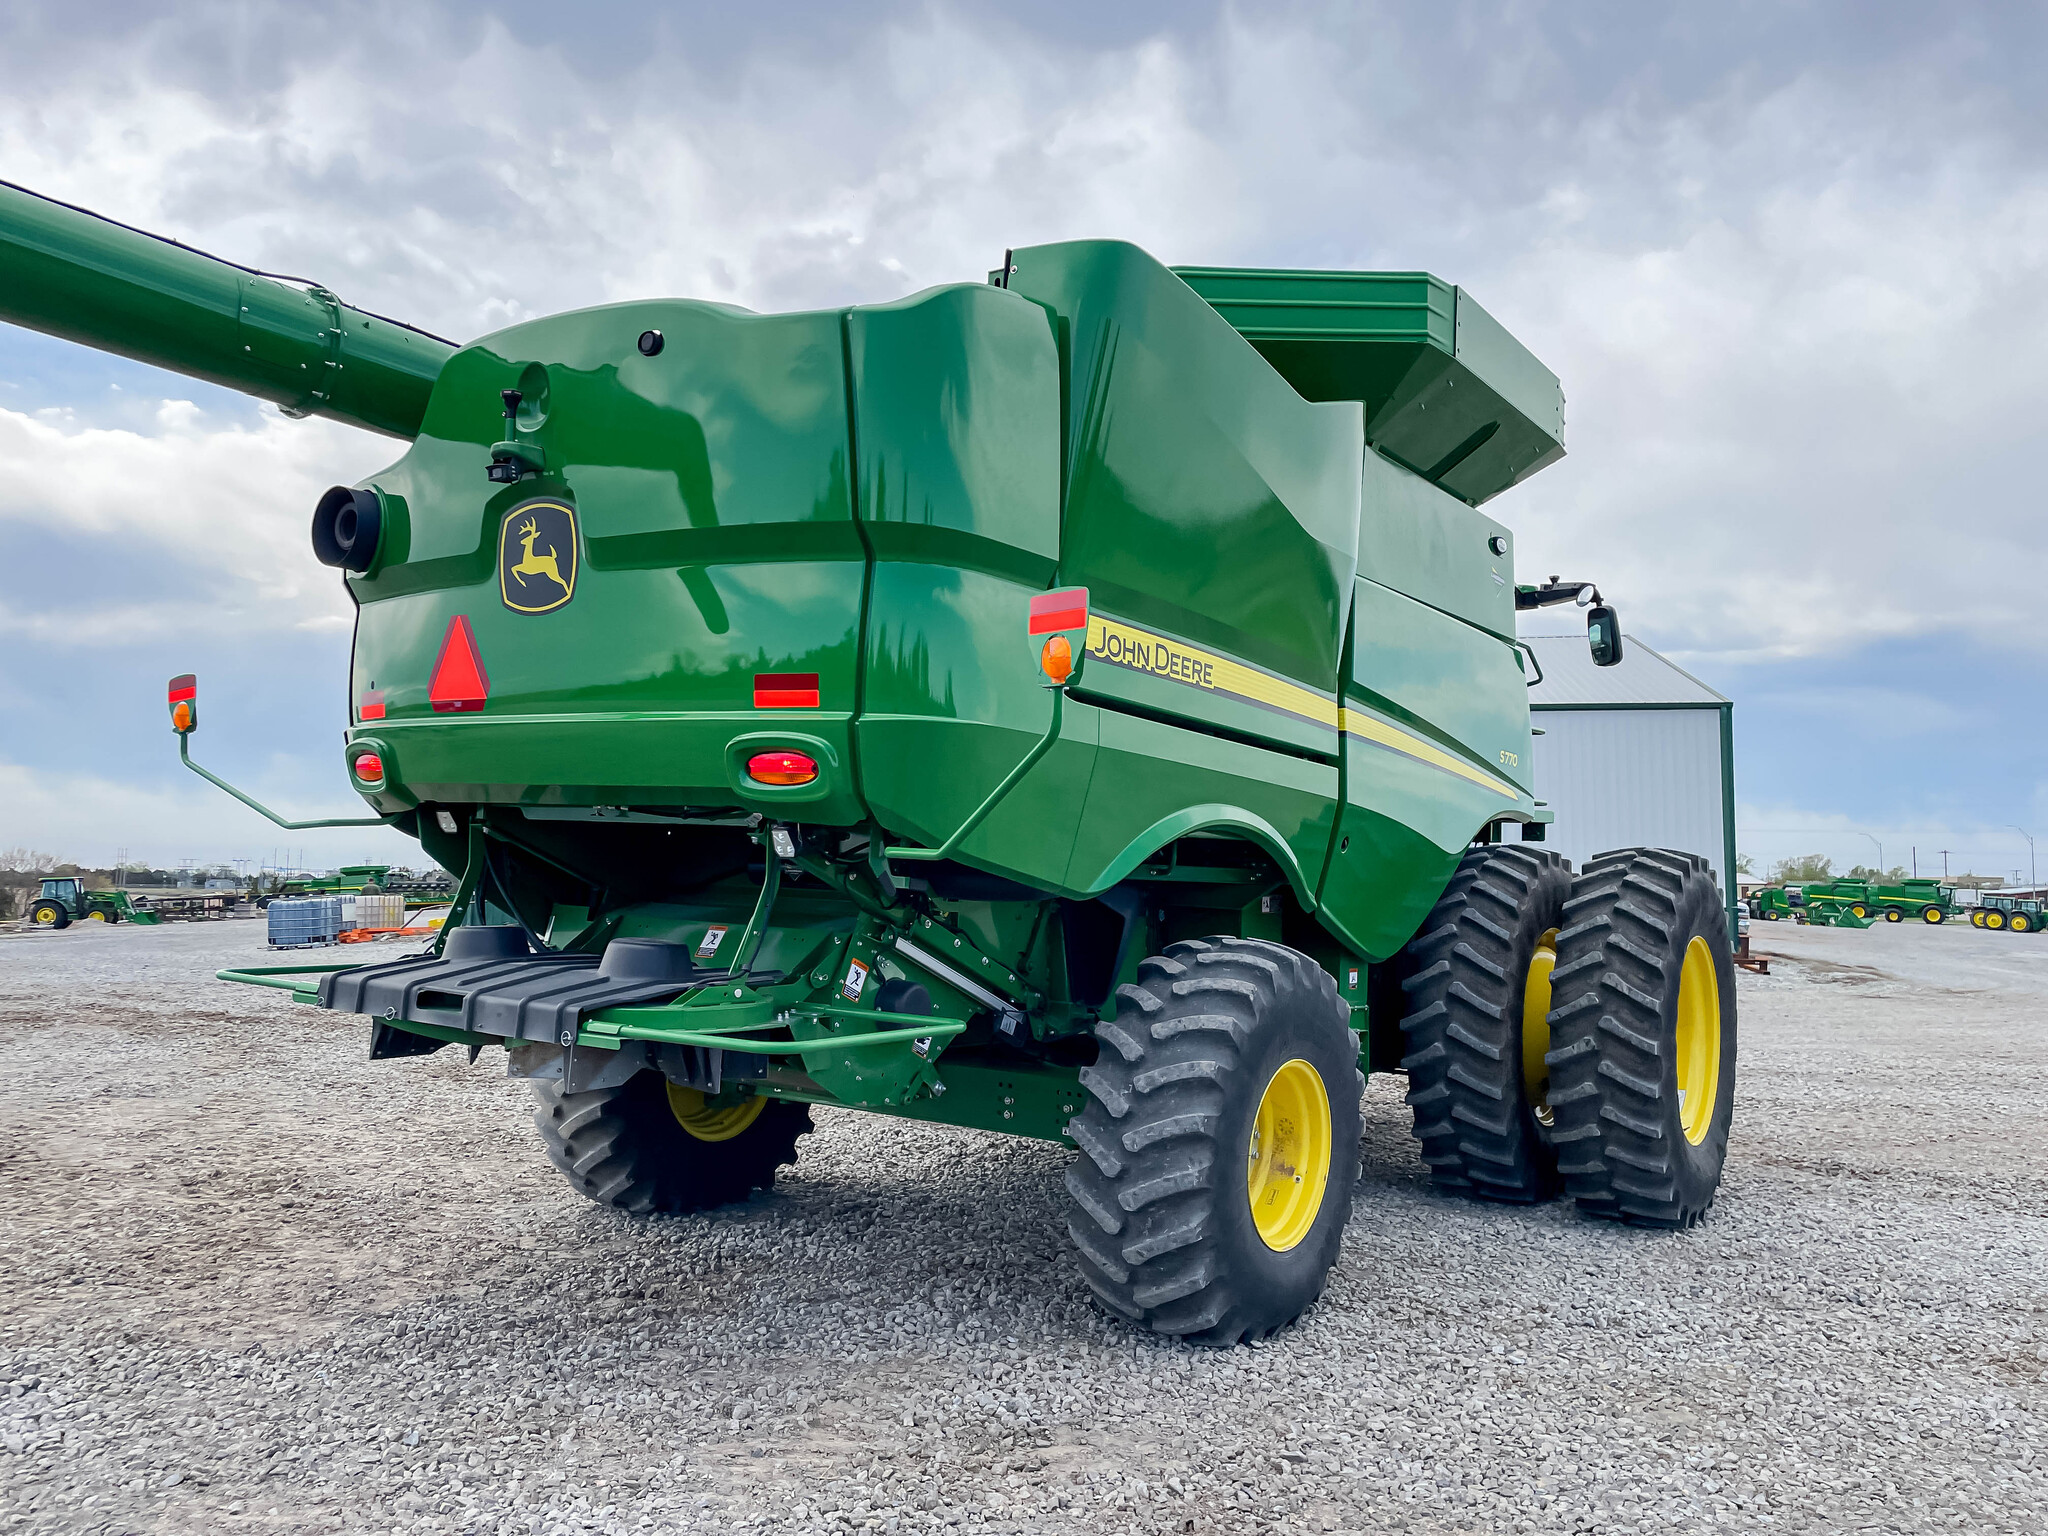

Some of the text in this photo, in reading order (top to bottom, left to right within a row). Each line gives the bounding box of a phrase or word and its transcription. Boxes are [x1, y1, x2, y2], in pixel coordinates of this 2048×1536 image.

[1094, 626, 1214, 686] JOHN DEERE
[1499, 750, 1518, 768] S770
